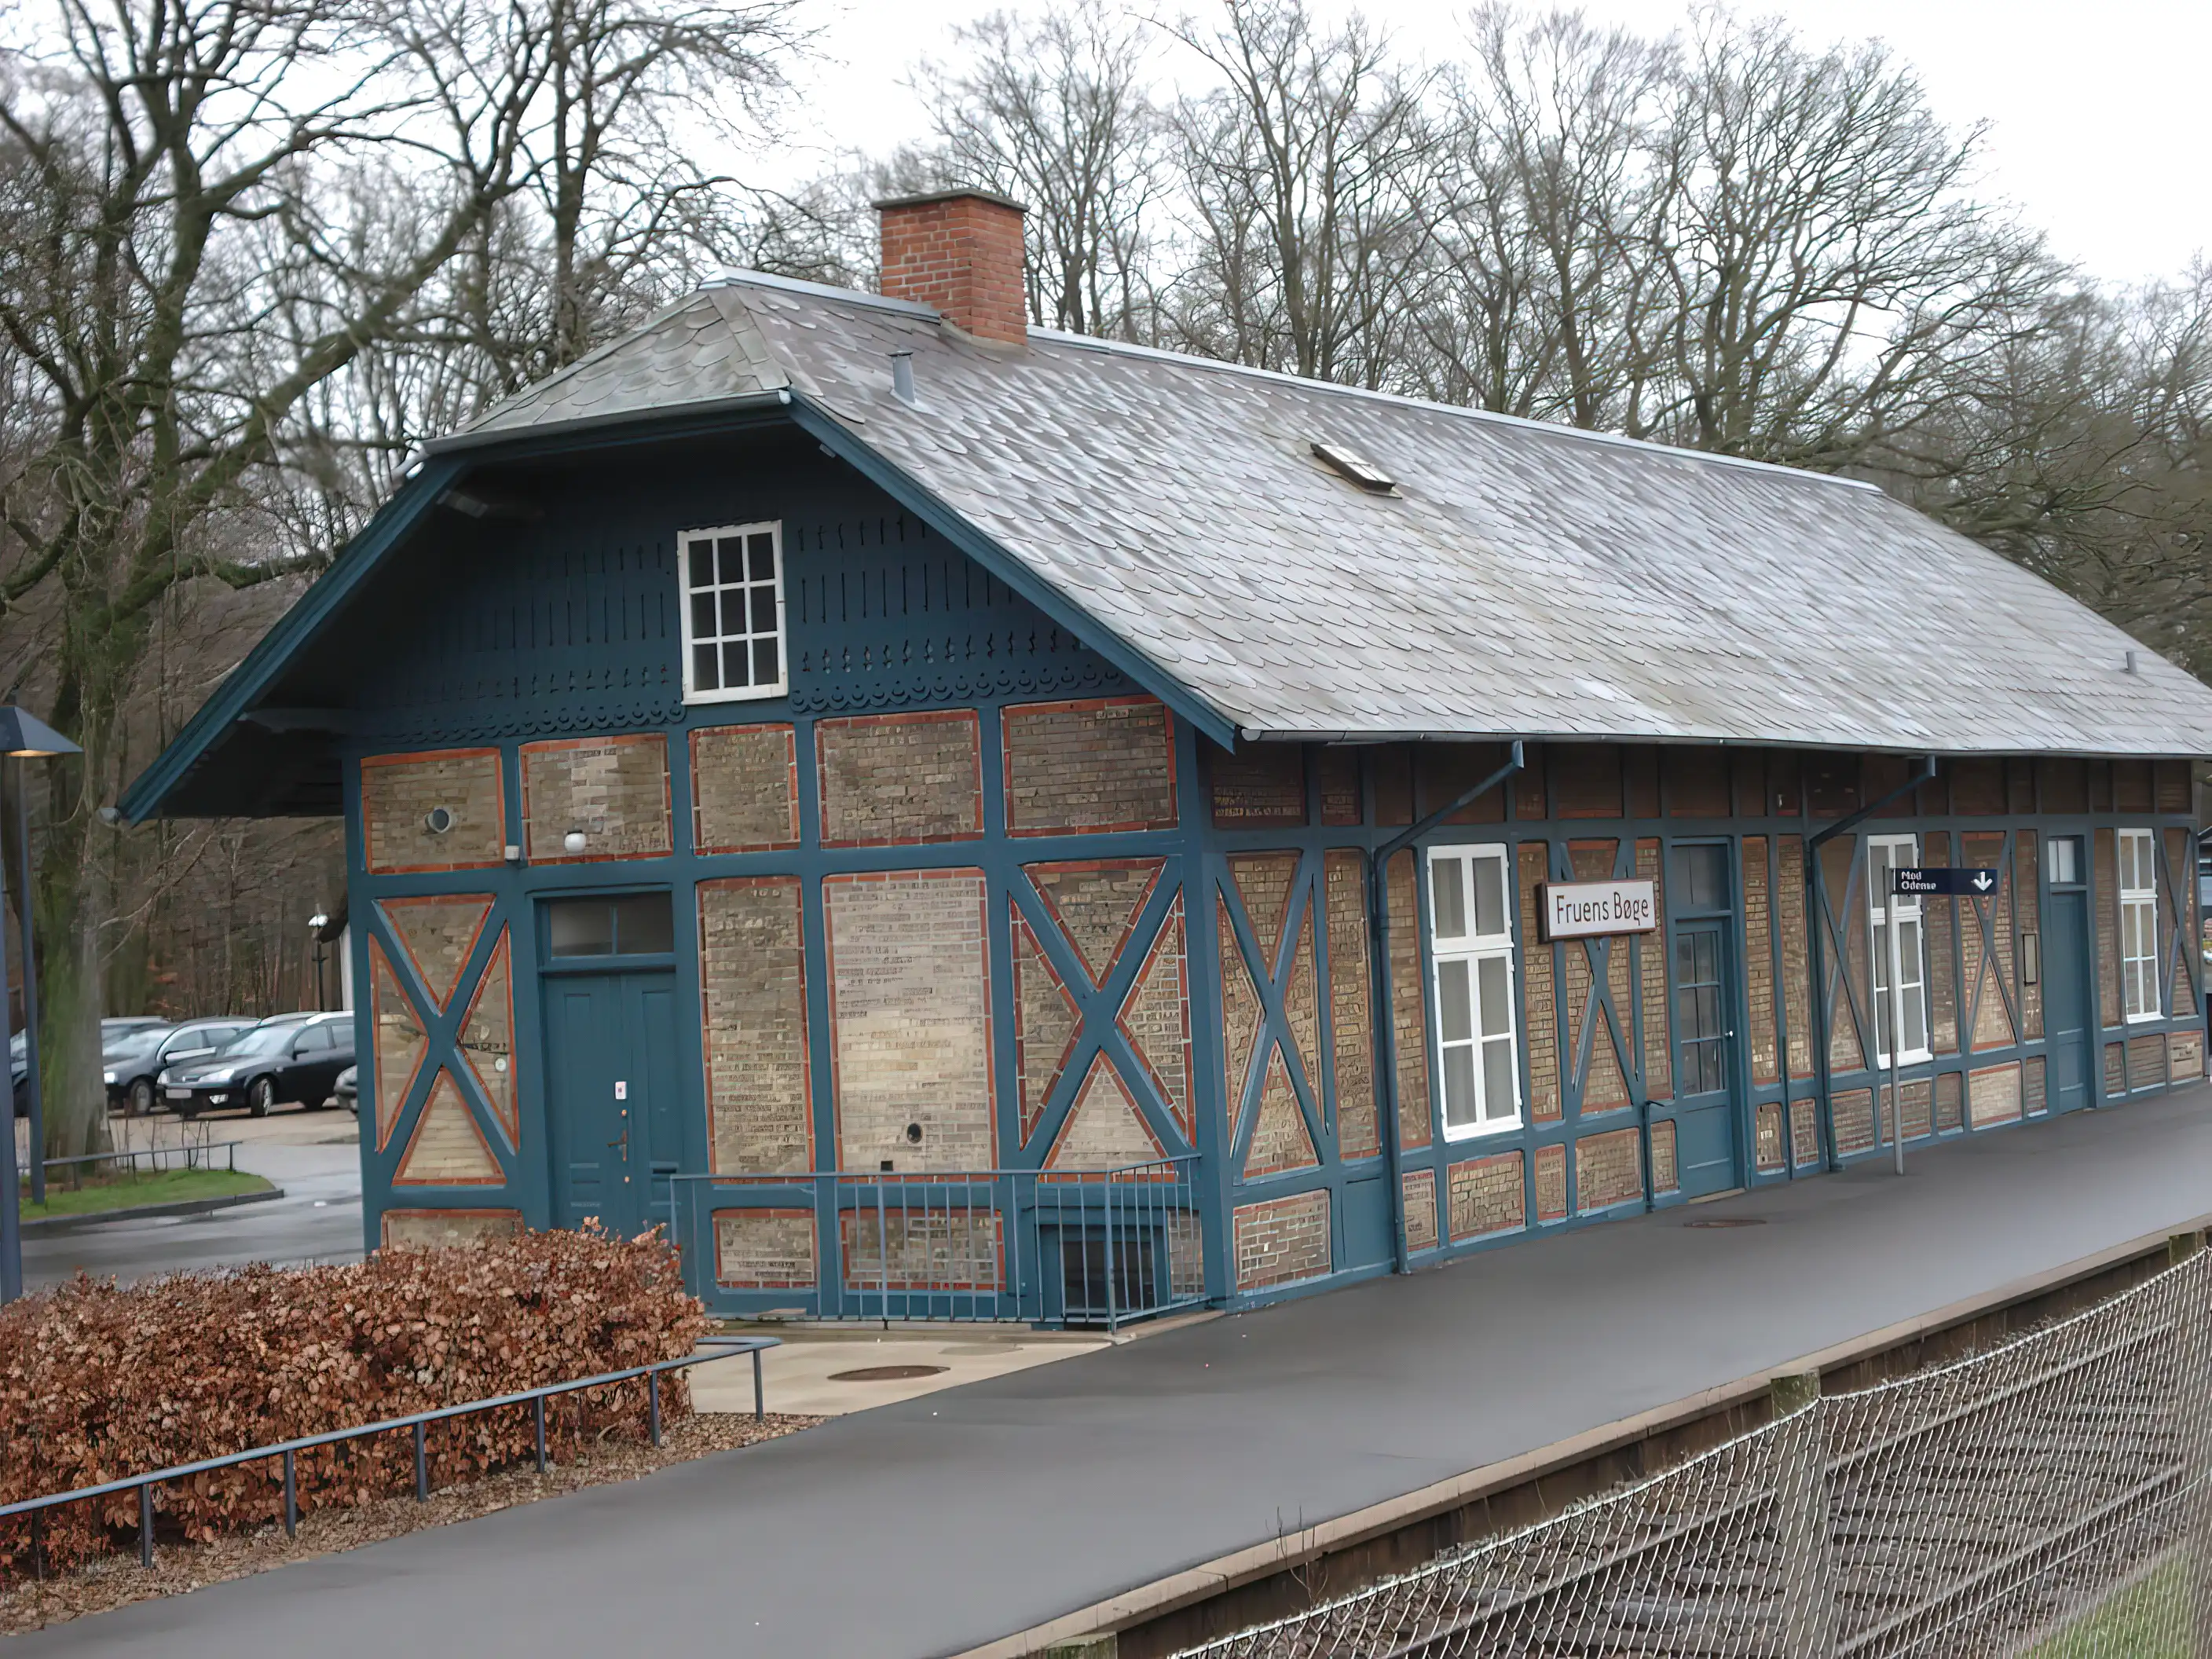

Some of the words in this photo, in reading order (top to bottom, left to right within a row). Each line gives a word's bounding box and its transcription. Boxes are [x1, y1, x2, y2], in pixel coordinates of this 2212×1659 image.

[1902, 871, 1921, 880] Mod
[1556, 895, 1610, 924] Fruens
[1613, 892, 1650, 926] Bøge
